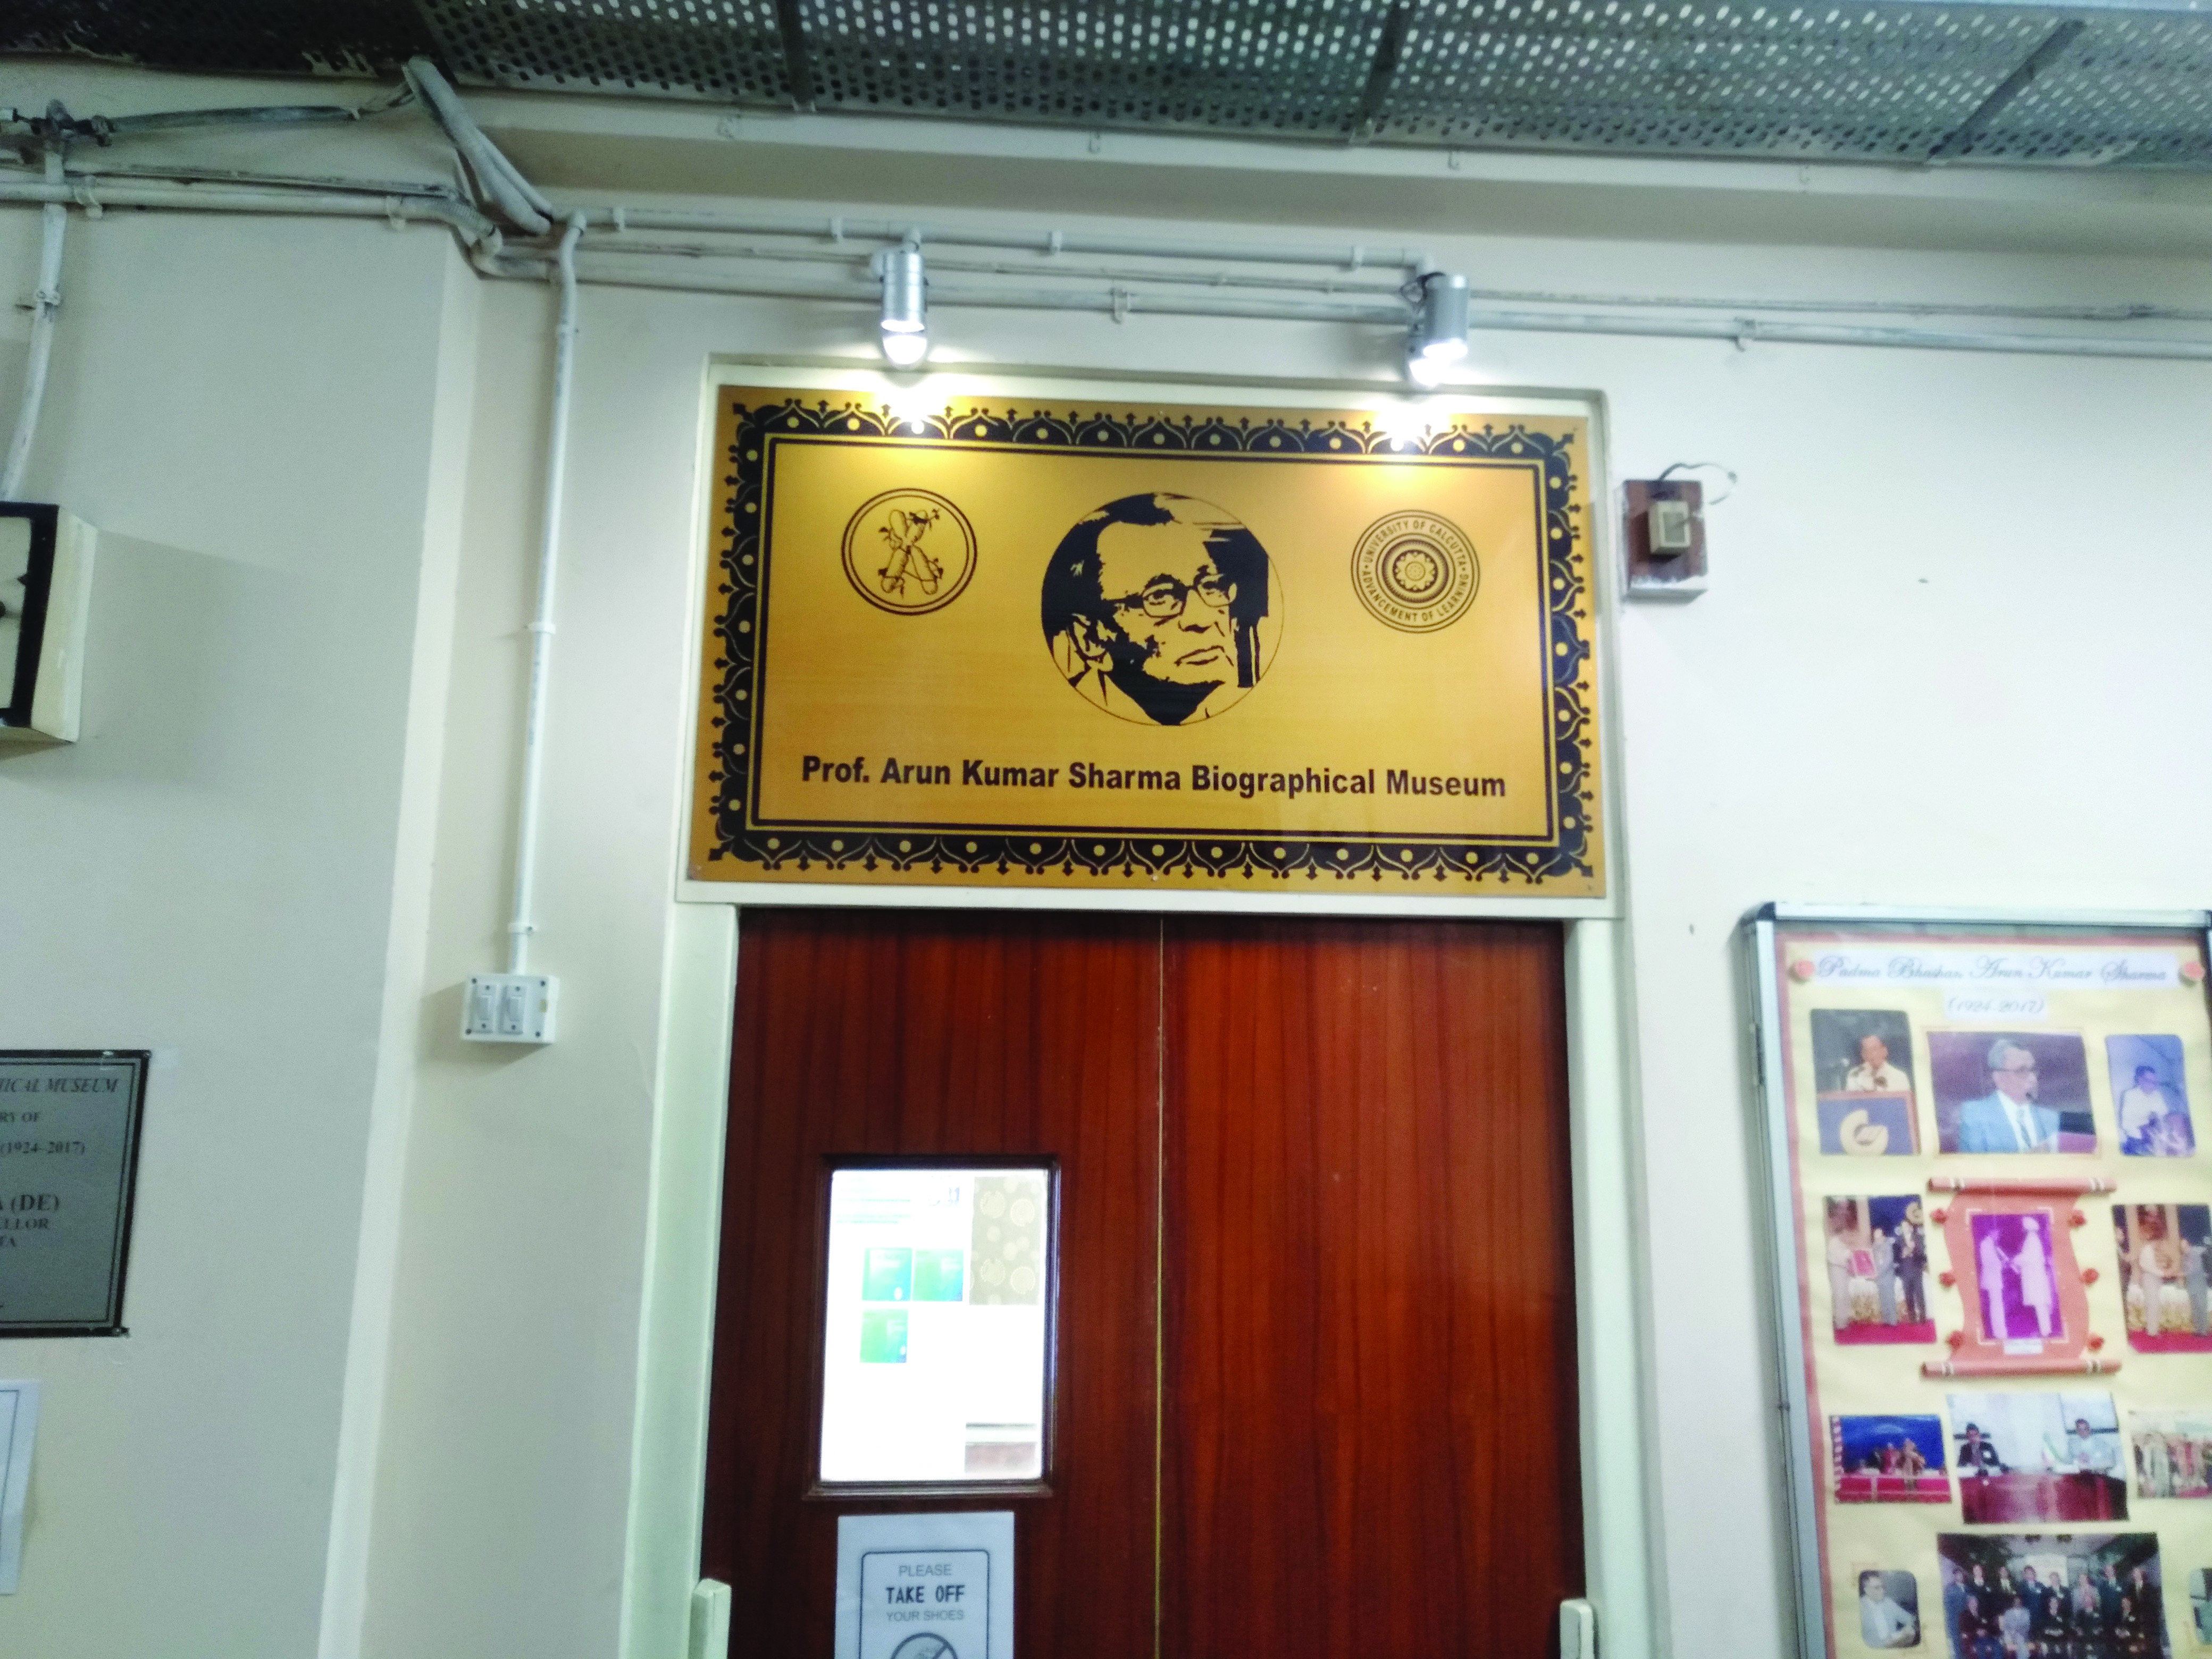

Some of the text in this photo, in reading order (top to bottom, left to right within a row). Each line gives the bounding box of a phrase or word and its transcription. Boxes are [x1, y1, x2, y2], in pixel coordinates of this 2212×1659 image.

[1363, 520, 1467, 566] UNIVERSITY OF CALCUTTA
[1361, 571, 1469, 622] ADVANCEMENT OF LEARNING
[802, 755, 1506, 799] Prof. Arun Kumar Sharma Biographical Museum
[1817, 955, 1881, 978] Padma
[1970, 955, 2022, 979] Arun
[2027, 956, 2093, 979] Kumar
[2100, 958, 2167, 984] Sharma
[46, 1078, 119, 1093] MUSEUM
[11, 1193, 60, 1214] (DE)
[0, 1218, 49, 1230] LLOR
[898, 1564, 952, 1577] PLEASE
[886, 1585, 966, 1604] TAKE OFF
[886, 1610, 966, 1622] YOUR SHOES
